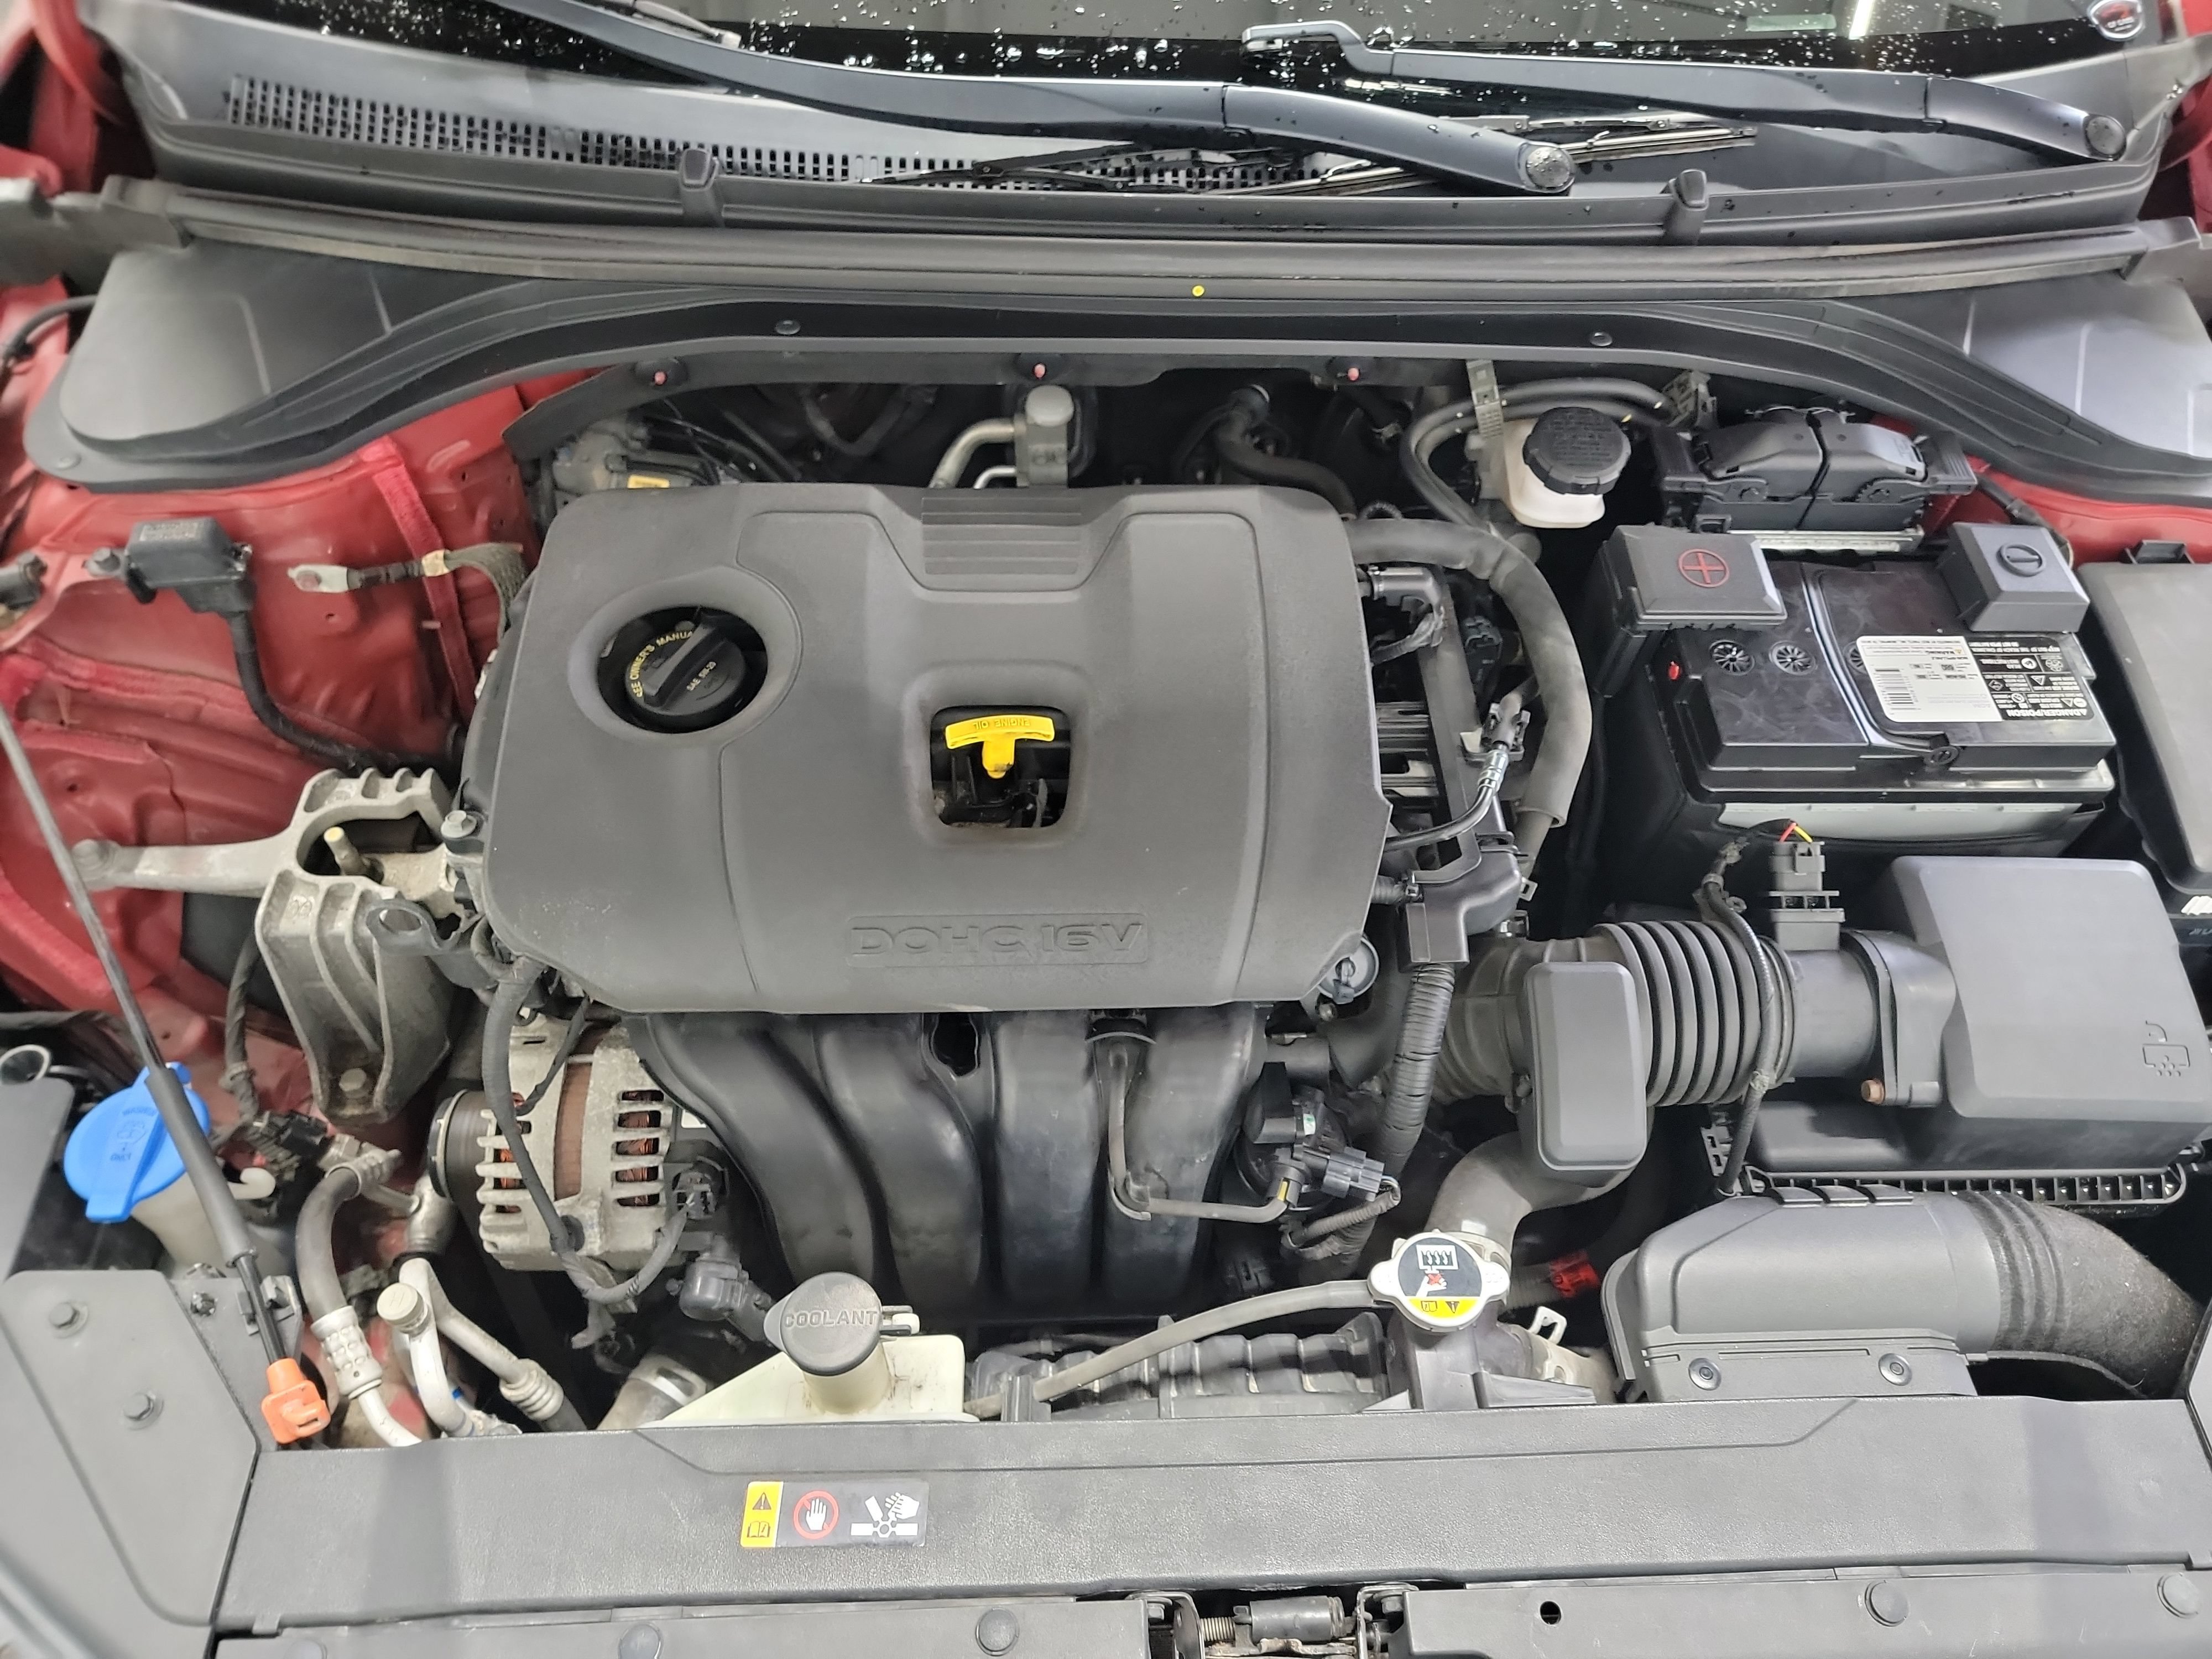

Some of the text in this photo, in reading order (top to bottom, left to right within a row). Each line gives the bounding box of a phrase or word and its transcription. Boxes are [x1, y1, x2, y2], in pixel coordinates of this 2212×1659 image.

[629, 631, 693, 697] SEE OWNER'S MANUA
[2006, 708, 2081, 717] DANGER/POISON
[973, 718, 1030, 730] ENGINE OIL
[851, 922, 1144, 956] DOHC 16V
[784, 1310, 878, 1328] COOLANT
